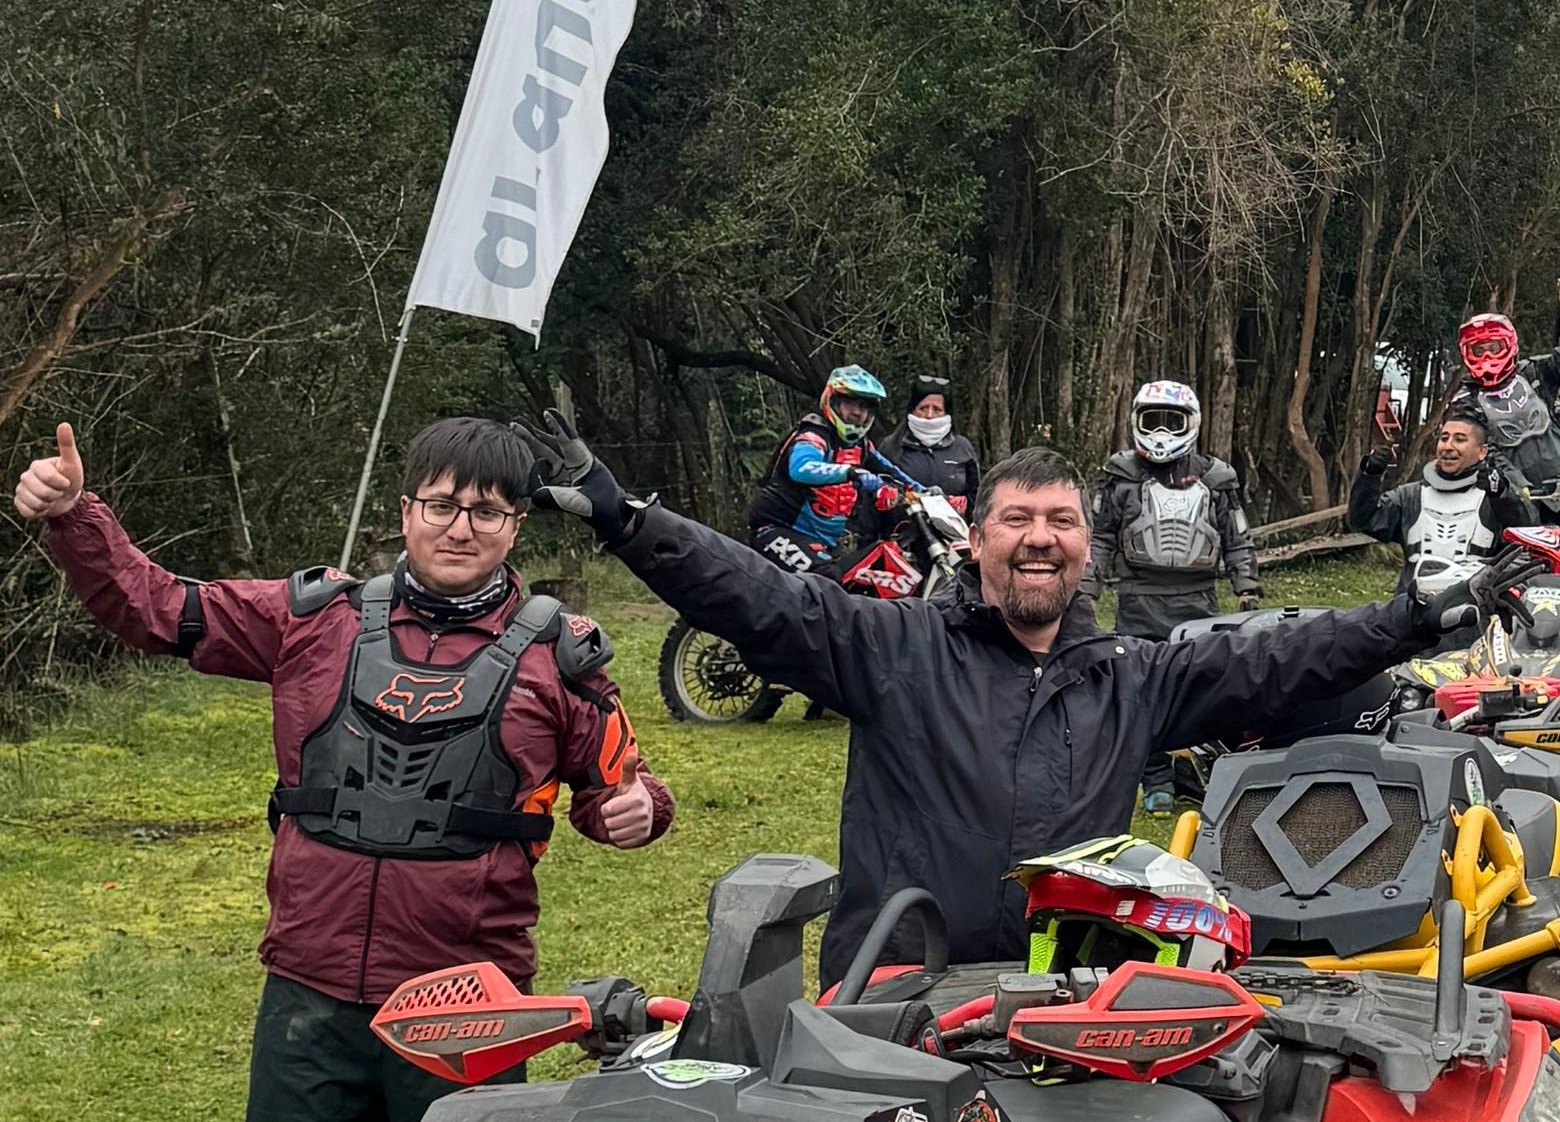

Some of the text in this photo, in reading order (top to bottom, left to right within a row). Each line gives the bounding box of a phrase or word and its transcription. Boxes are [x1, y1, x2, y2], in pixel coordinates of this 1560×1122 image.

[1144, 900, 1233, 943] 100%
[404, 1019, 505, 1043] can-am
[1075, 1026, 1193, 1048] can-am
